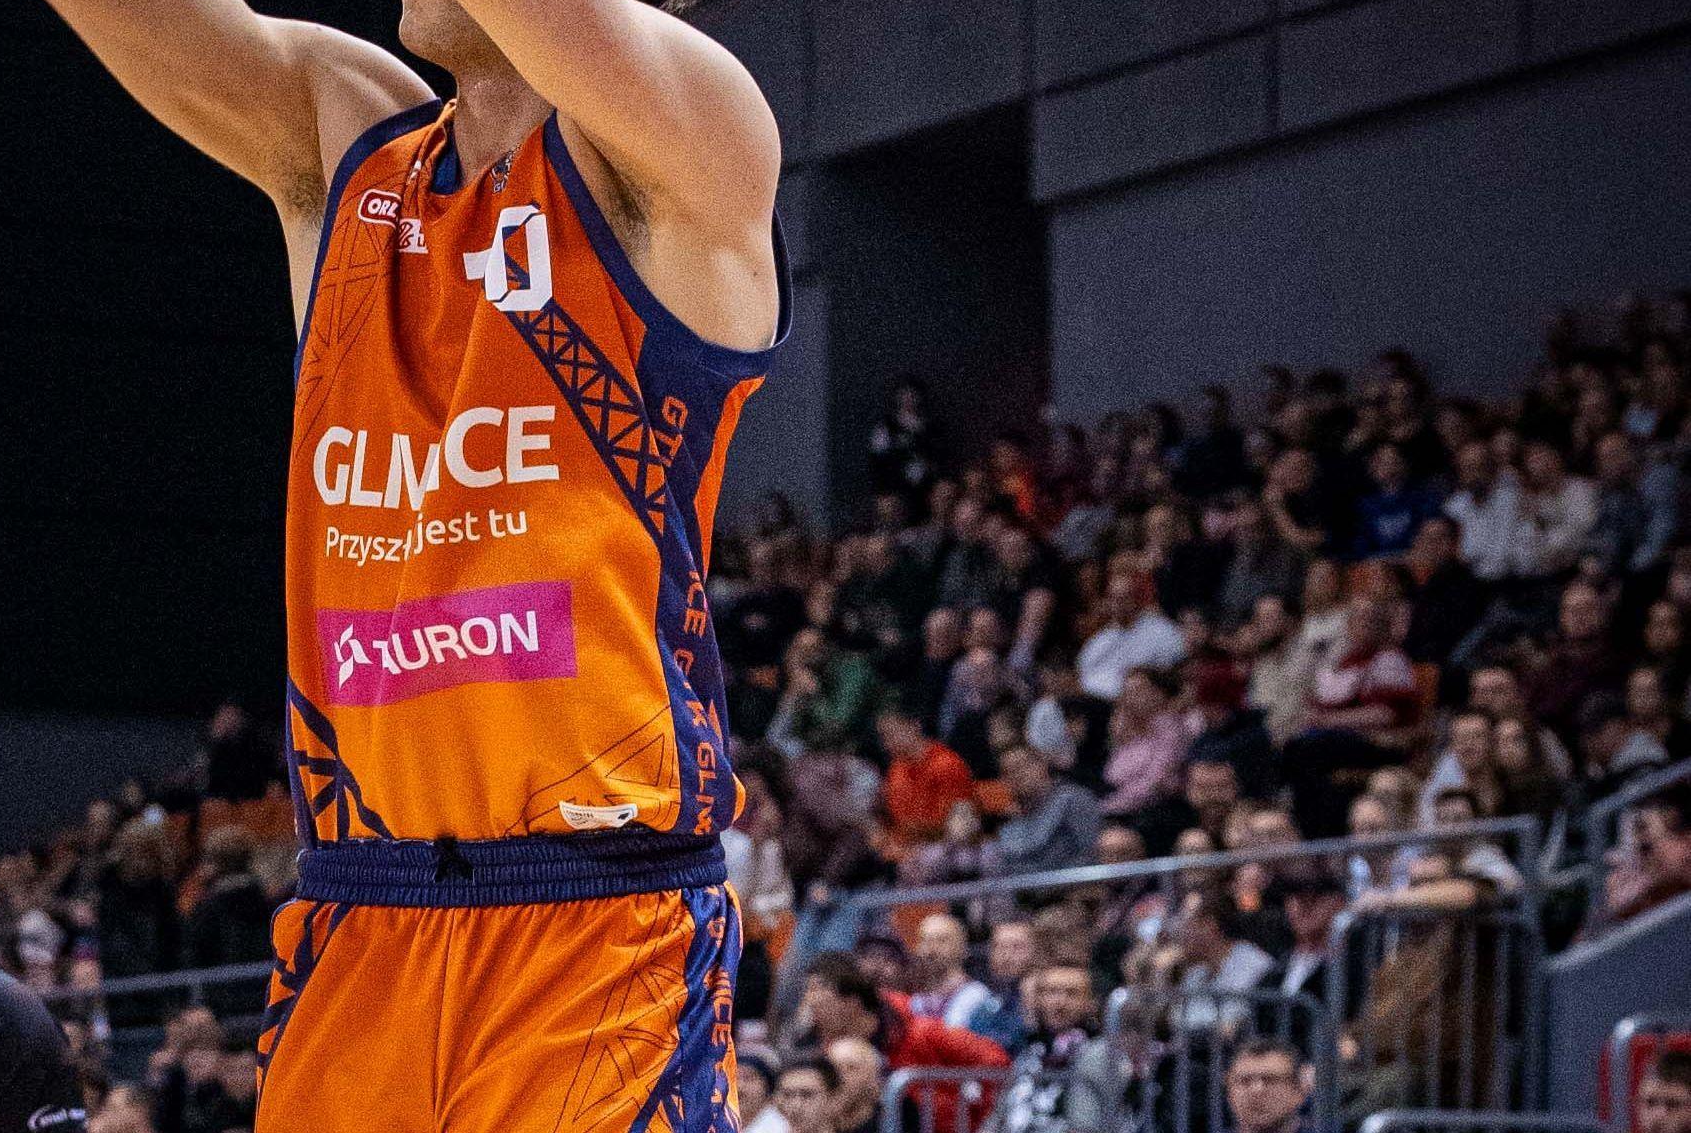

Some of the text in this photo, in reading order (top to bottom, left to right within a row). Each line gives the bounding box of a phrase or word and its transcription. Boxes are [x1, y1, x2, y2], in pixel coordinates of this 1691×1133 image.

[367, 198, 399, 219] ORL
[414, 512, 480, 554] jest
[489, 508, 528, 539] tu
